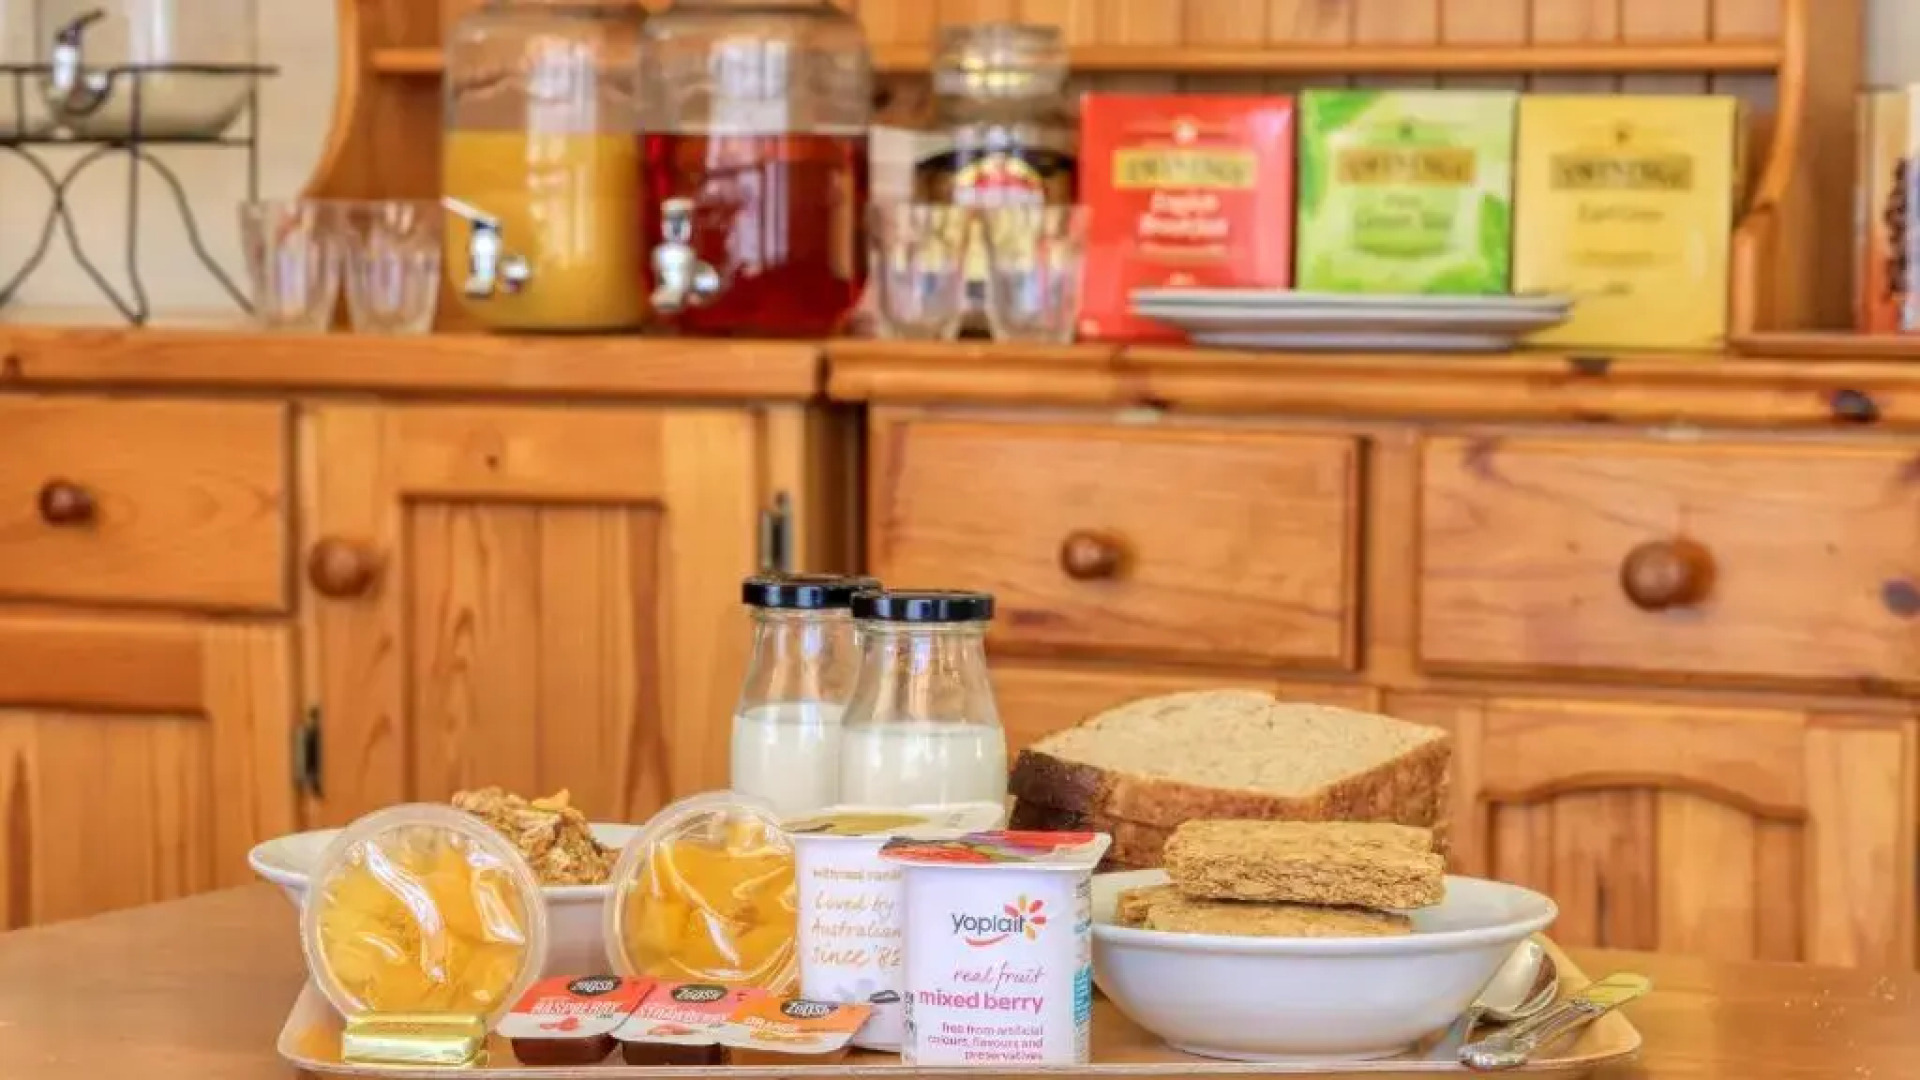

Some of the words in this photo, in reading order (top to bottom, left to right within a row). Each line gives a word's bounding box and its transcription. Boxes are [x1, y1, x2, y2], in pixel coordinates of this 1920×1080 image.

[811, 917, 901, 938] Australian
[953, 966, 993, 984] real
[989, 960, 1044, 993] fruit
[919, 990, 979, 1010] mixed
[984, 992, 1043, 1014] berry
[942, 1021, 965, 1034] free
[967, 1022, 994, 1036] from
[997, 1024, 1043, 1036] artificial
[928, 1033, 970, 1046] colours,
[972, 1036, 1018, 1049] flavours
[1021, 1037, 1043, 1048] and
[965, 1048, 1043, 1062] preservatives
